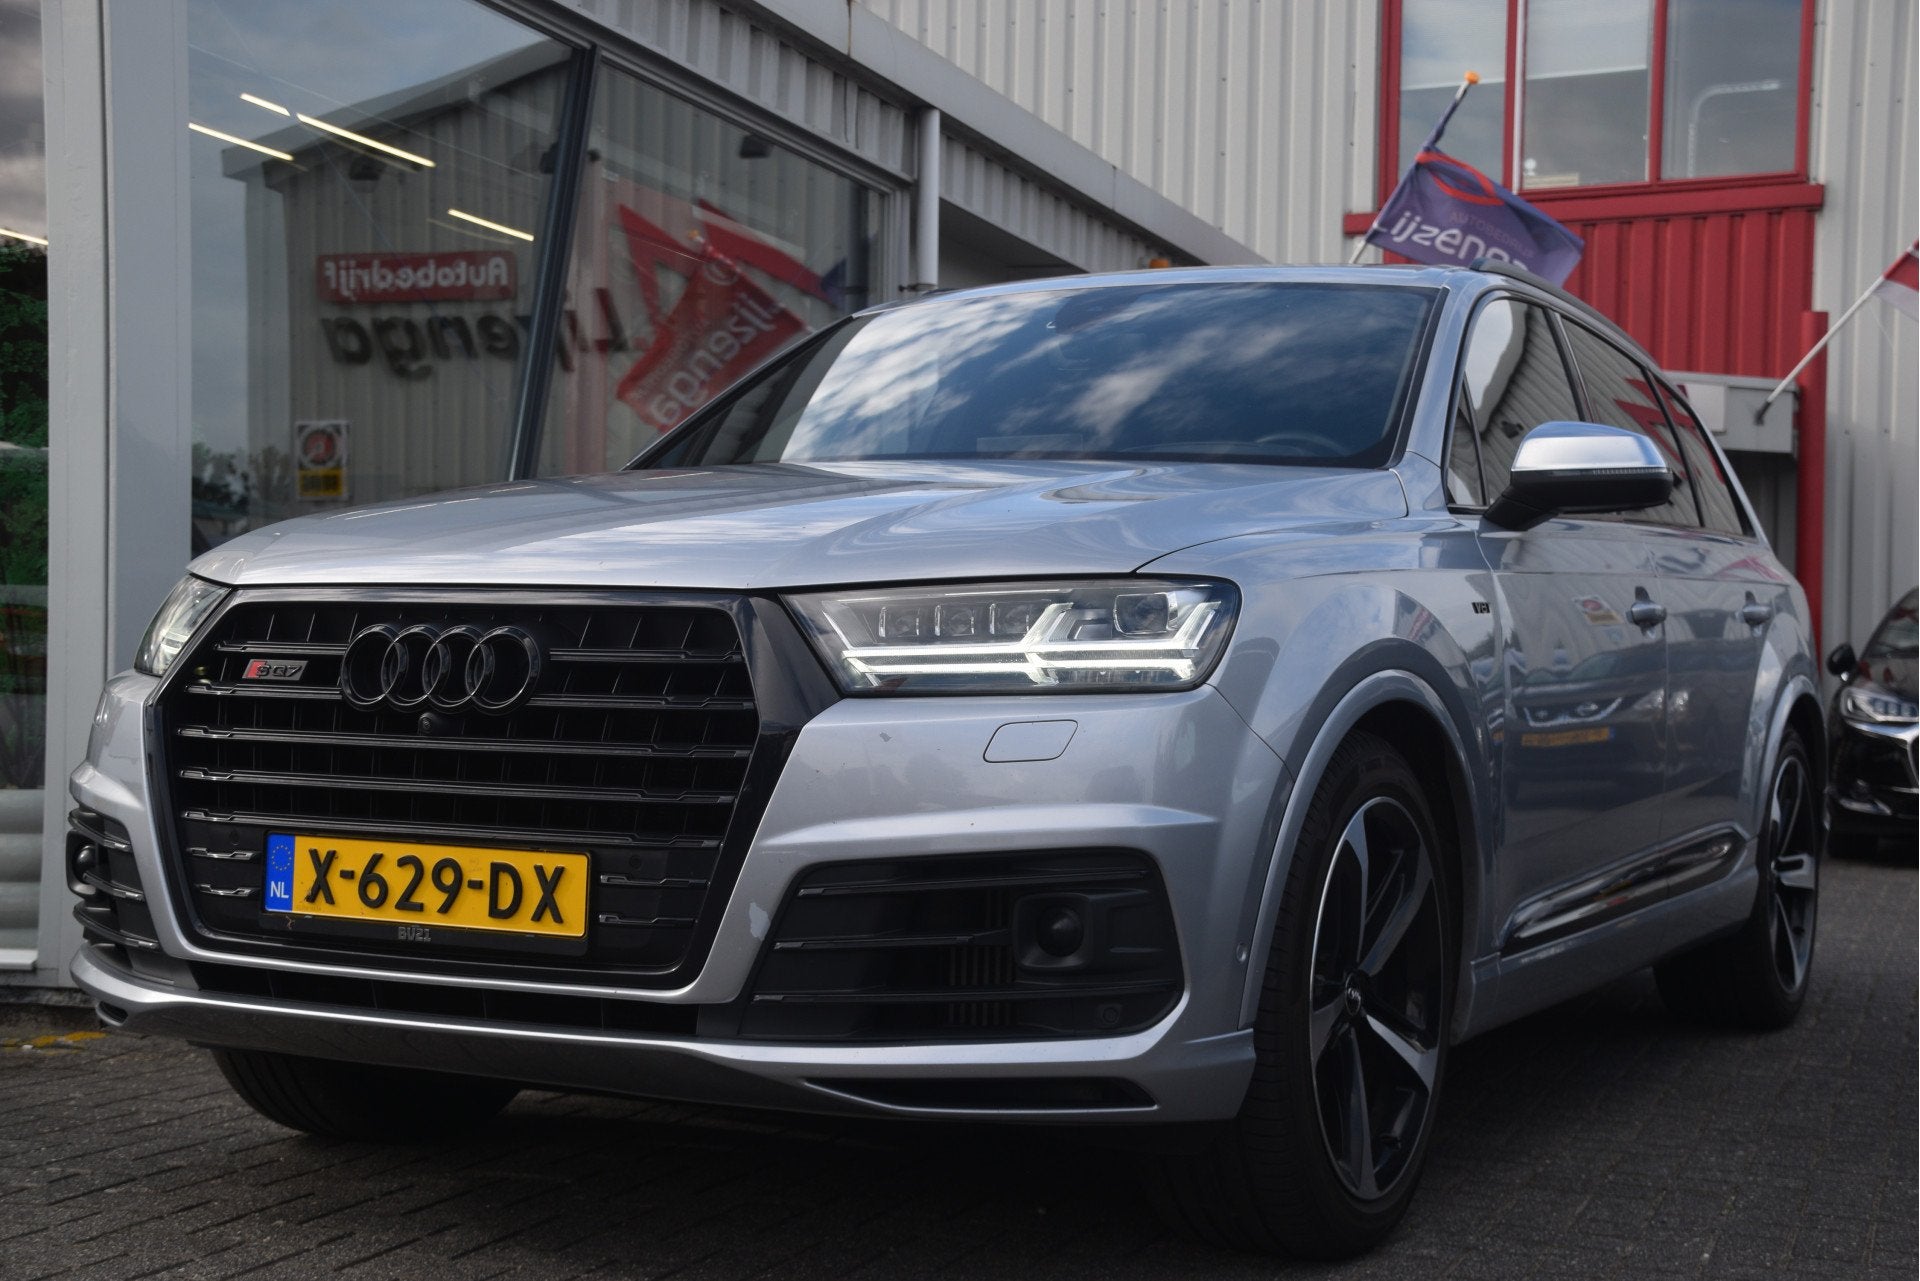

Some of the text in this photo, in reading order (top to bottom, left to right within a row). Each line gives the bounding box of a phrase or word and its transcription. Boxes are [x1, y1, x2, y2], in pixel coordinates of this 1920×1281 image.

[253, 663, 303, 678] SQ7
[270, 881, 289, 899] NL
[305, 848, 565, 924] X-629-DX
